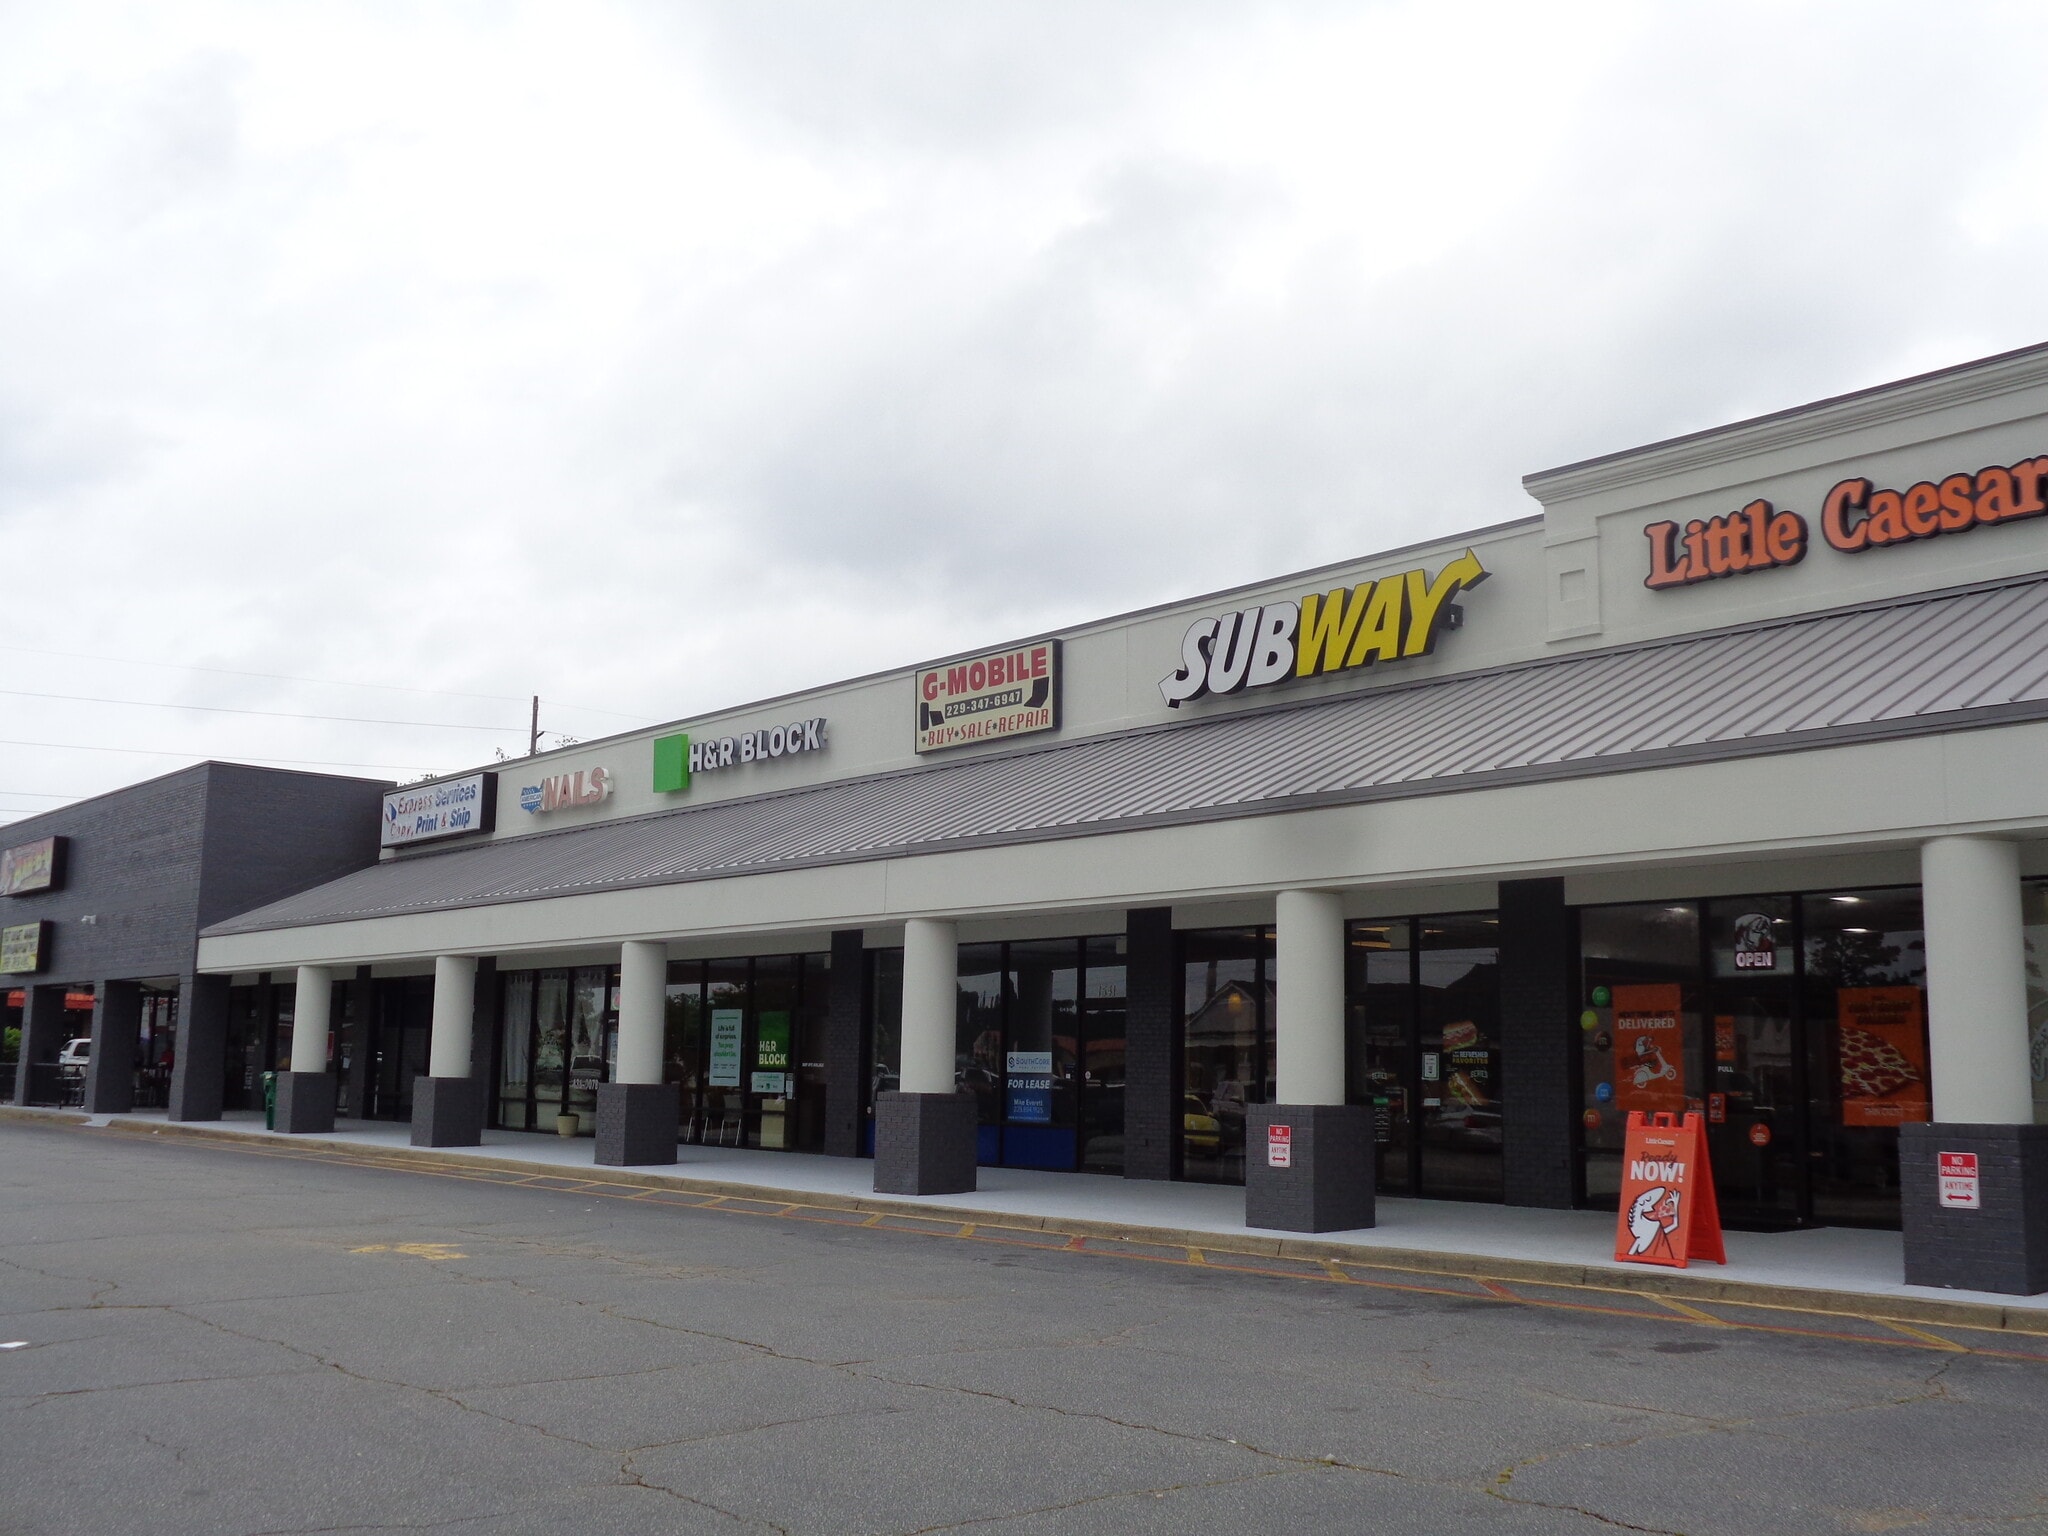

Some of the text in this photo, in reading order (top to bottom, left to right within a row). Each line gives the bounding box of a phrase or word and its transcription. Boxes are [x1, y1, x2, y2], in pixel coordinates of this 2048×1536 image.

[1645, 456, 2048, 589] Little Caesar
[1159, 547, 1484, 706] SUBWAY
[923, 647, 1047, 701] G-MOBILE
[946, 693, 1021, 717] 229-347-6947
[928, 709, 1049, 746] BUY SALE REPAIR
[689, 718, 823, 773] H&R BLOCK
[398, 784, 477, 815] Express Services
[544, 767, 606, 811] NAILS
[415, 814, 439, 834] Print
[450, 807, 471, 828] Ship
[1736, 952, 1772, 967] OPEN
[1618, 1018, 1676, 1029] DELIVERED
[759, 1041, 777, 1051] H&R
[758, 1054, 786, 1064] BLOCK
[1008, 1079, 1050, 1089] FOR LEASE
[1276, 1128, 1283, 1136] NO
[1641, 1150, 1679, 1169] Ready
[1951, 1156, 1963, 1166] NO
[1631, 1160, 1686, 1183] NOW!
[1941, 1166, 1977, 1177] PARKING
[1944, 1181, 1974, 1191] ANYTIME
